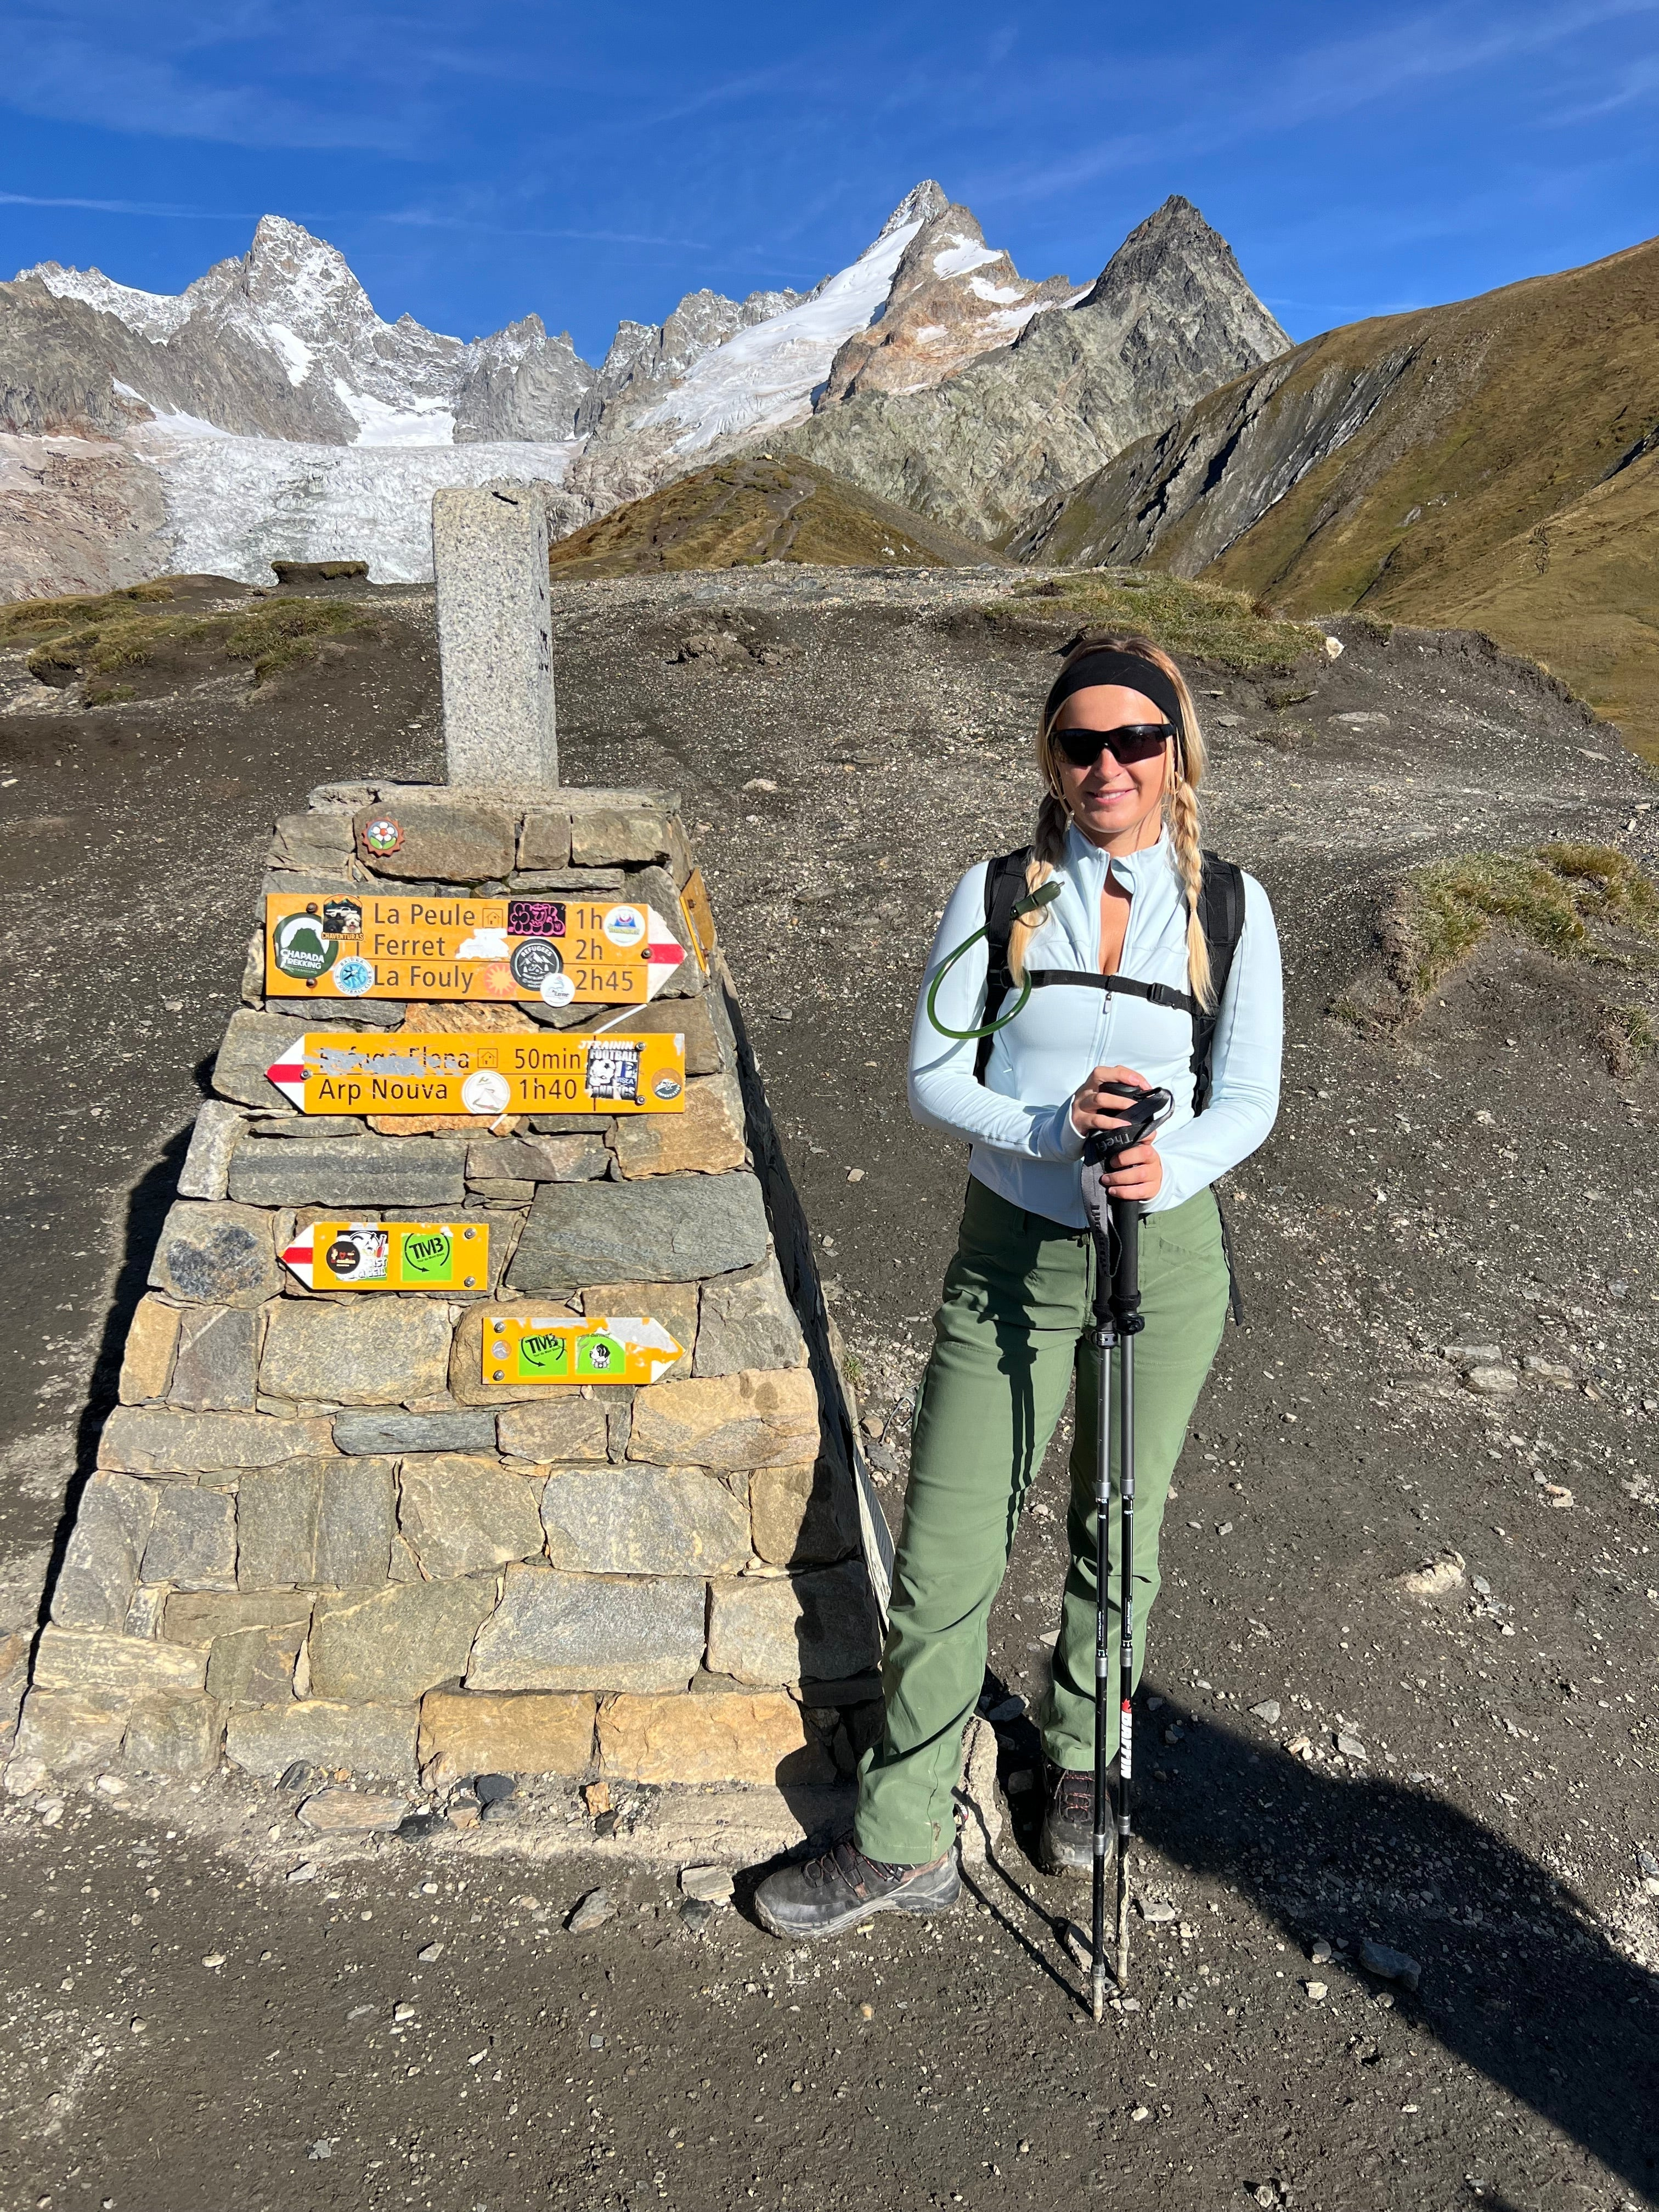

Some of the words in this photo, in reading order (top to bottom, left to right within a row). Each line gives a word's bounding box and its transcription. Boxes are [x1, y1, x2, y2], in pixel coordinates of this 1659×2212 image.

[375, 903, 399, 924] La
[411, 904, 476, 926] Peule
[576, 908, 602, 930] 1h
[280, 949, 325, 963] CHAPADA
[375, 934, 445, 956] Ferret
[521, 946, 553, 957] REFUGEES
[576, 939, 602, 960] 2h
[280, 957, 321, 969] TREKKING
[375, 964, 399, 986] La
[411, 966, 473, 994] Fouly
[575, 970, 633, 991] 2h45
[515, 1047, 580, 1069] 50min
[590, 1048, 637, 1063] FOOTBALL
[319, 1079, 361, 1105] Arp
[373, 1079, 447, 1100] Nouva
[520, 1078, 577, 1100] 1h40
[409, 1238, 444, 1259] TMB
[1121, 1711, 1132, 1779] BAFFIN
